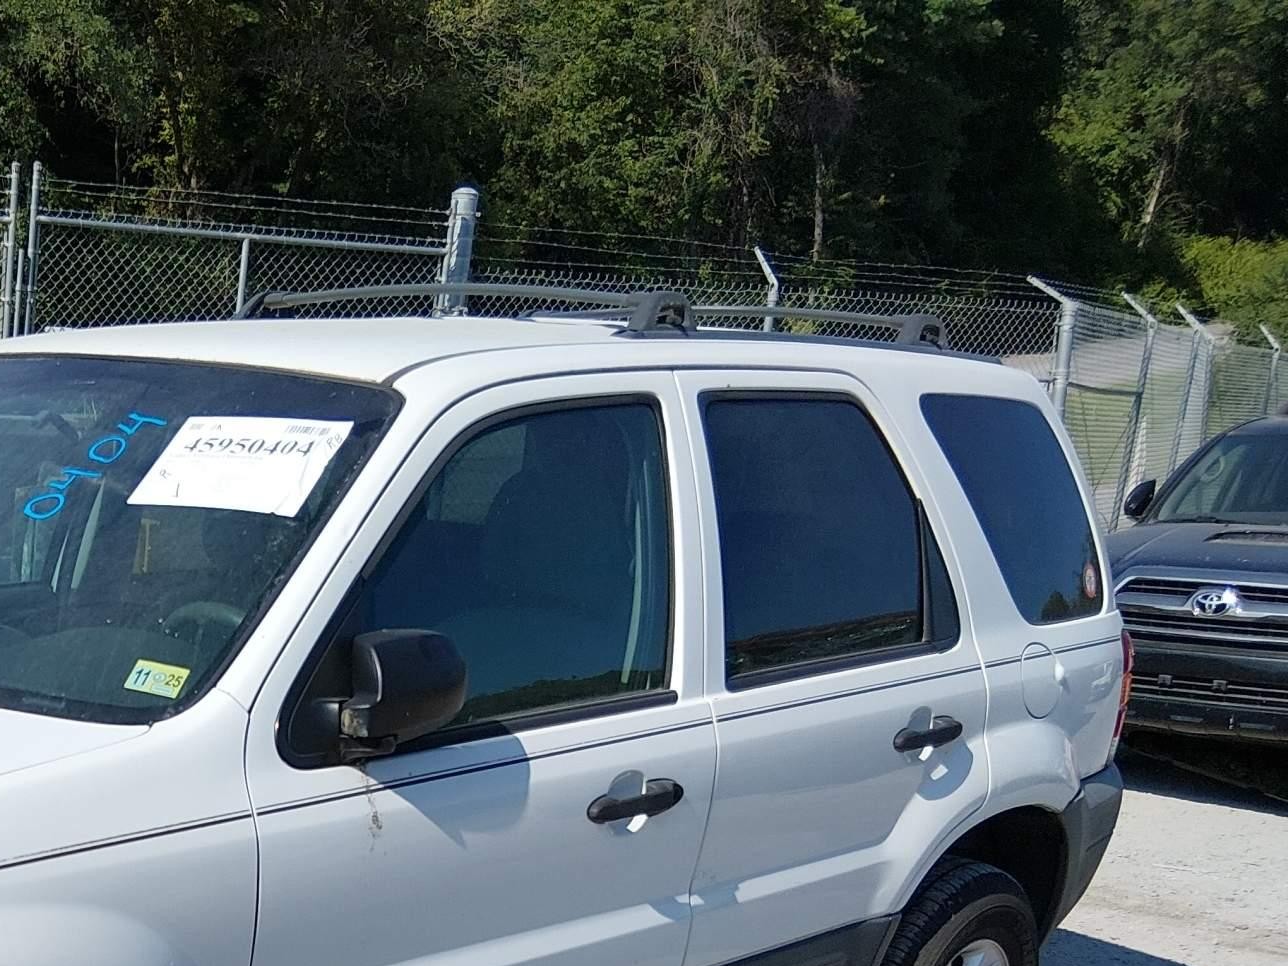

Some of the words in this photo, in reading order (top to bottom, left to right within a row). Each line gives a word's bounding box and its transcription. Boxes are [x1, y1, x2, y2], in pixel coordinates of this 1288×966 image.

[184, 437, 315, 457] 45950404
[24, 412, 167, 520] 0404
[133, 668, 152, 686] 11
[165, 674, 184, 688] 25
